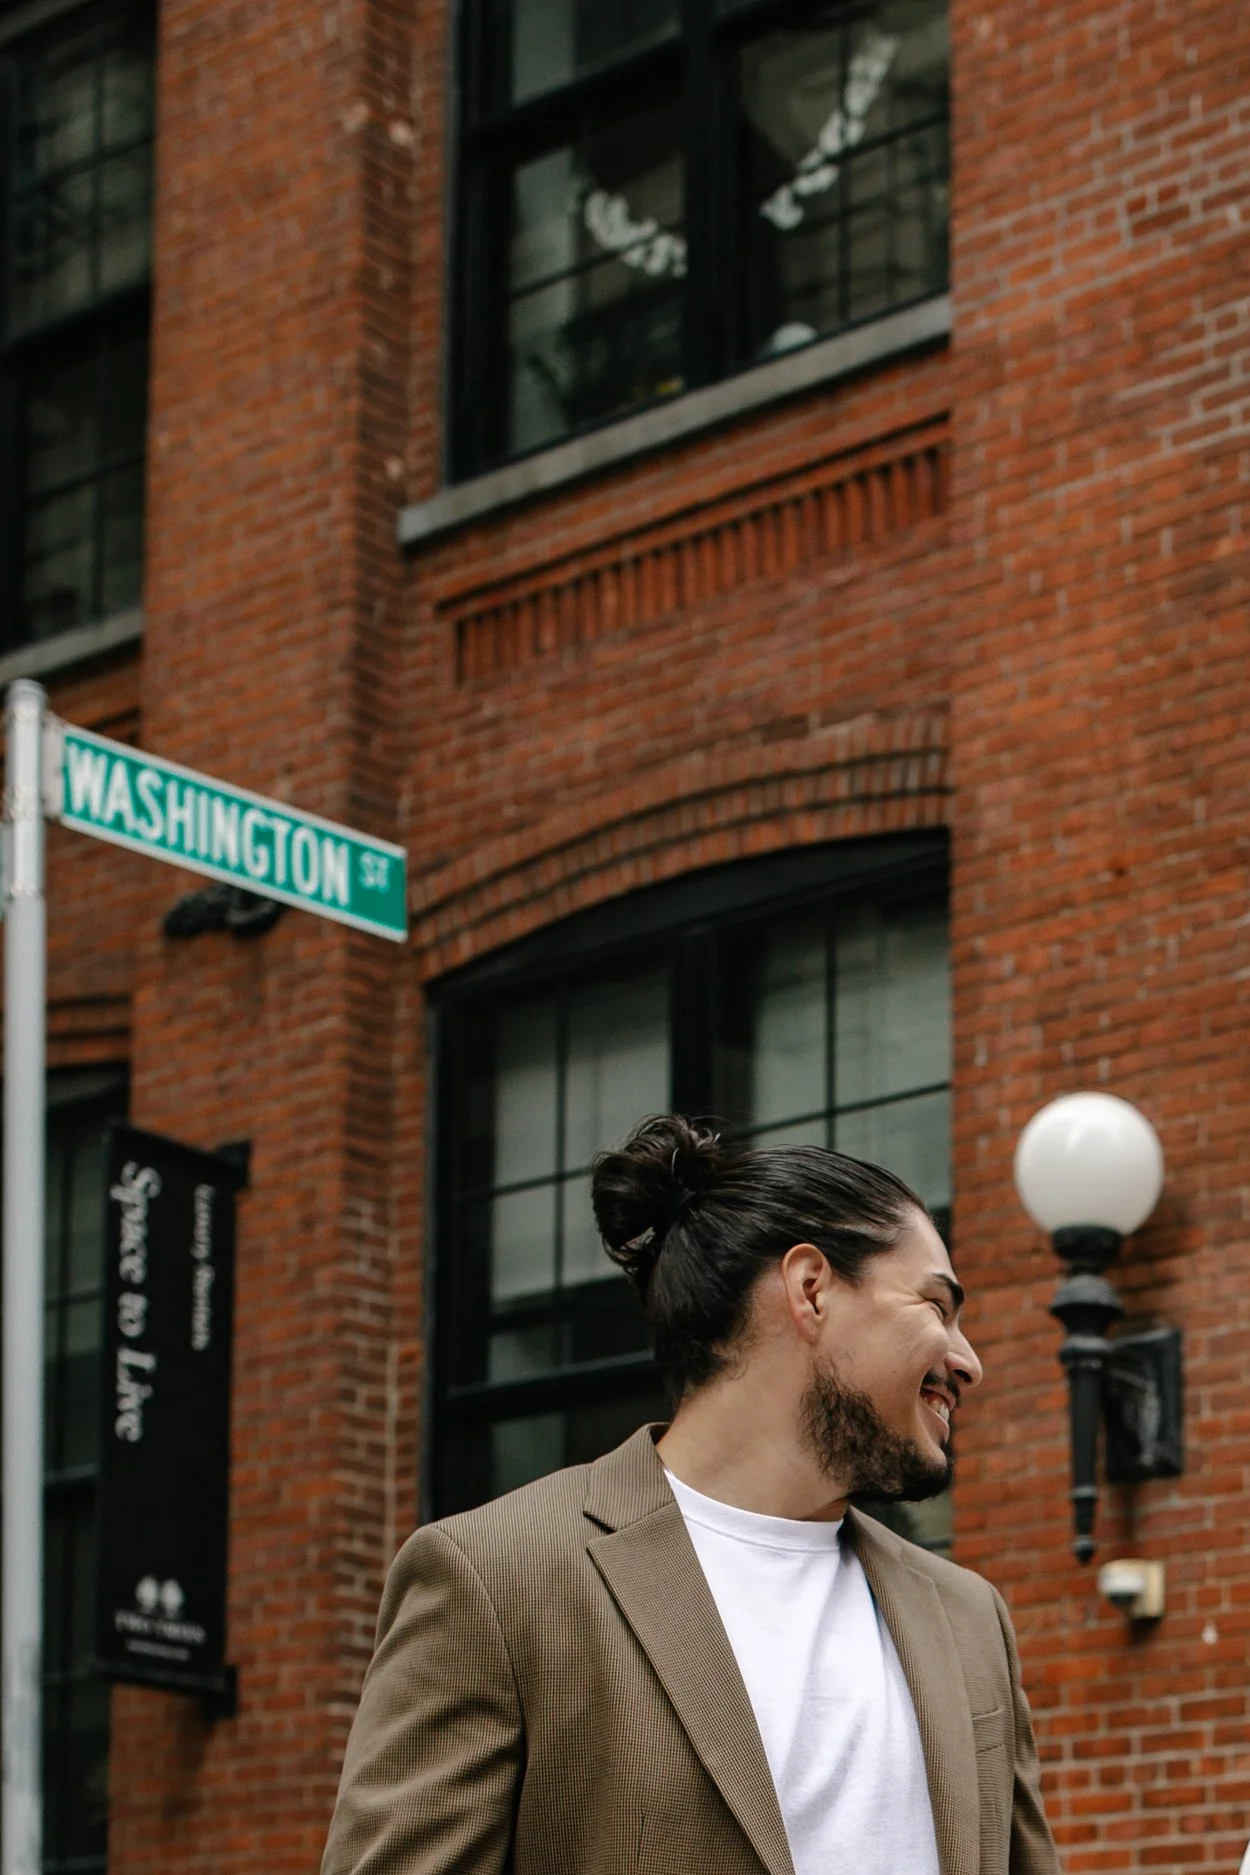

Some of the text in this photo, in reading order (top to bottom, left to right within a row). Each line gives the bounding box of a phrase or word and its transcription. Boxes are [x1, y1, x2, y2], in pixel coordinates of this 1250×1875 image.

[66, 741, 392, 906] WASHINGTON ST
[110, 1162, 161, 1442] Space to Live
